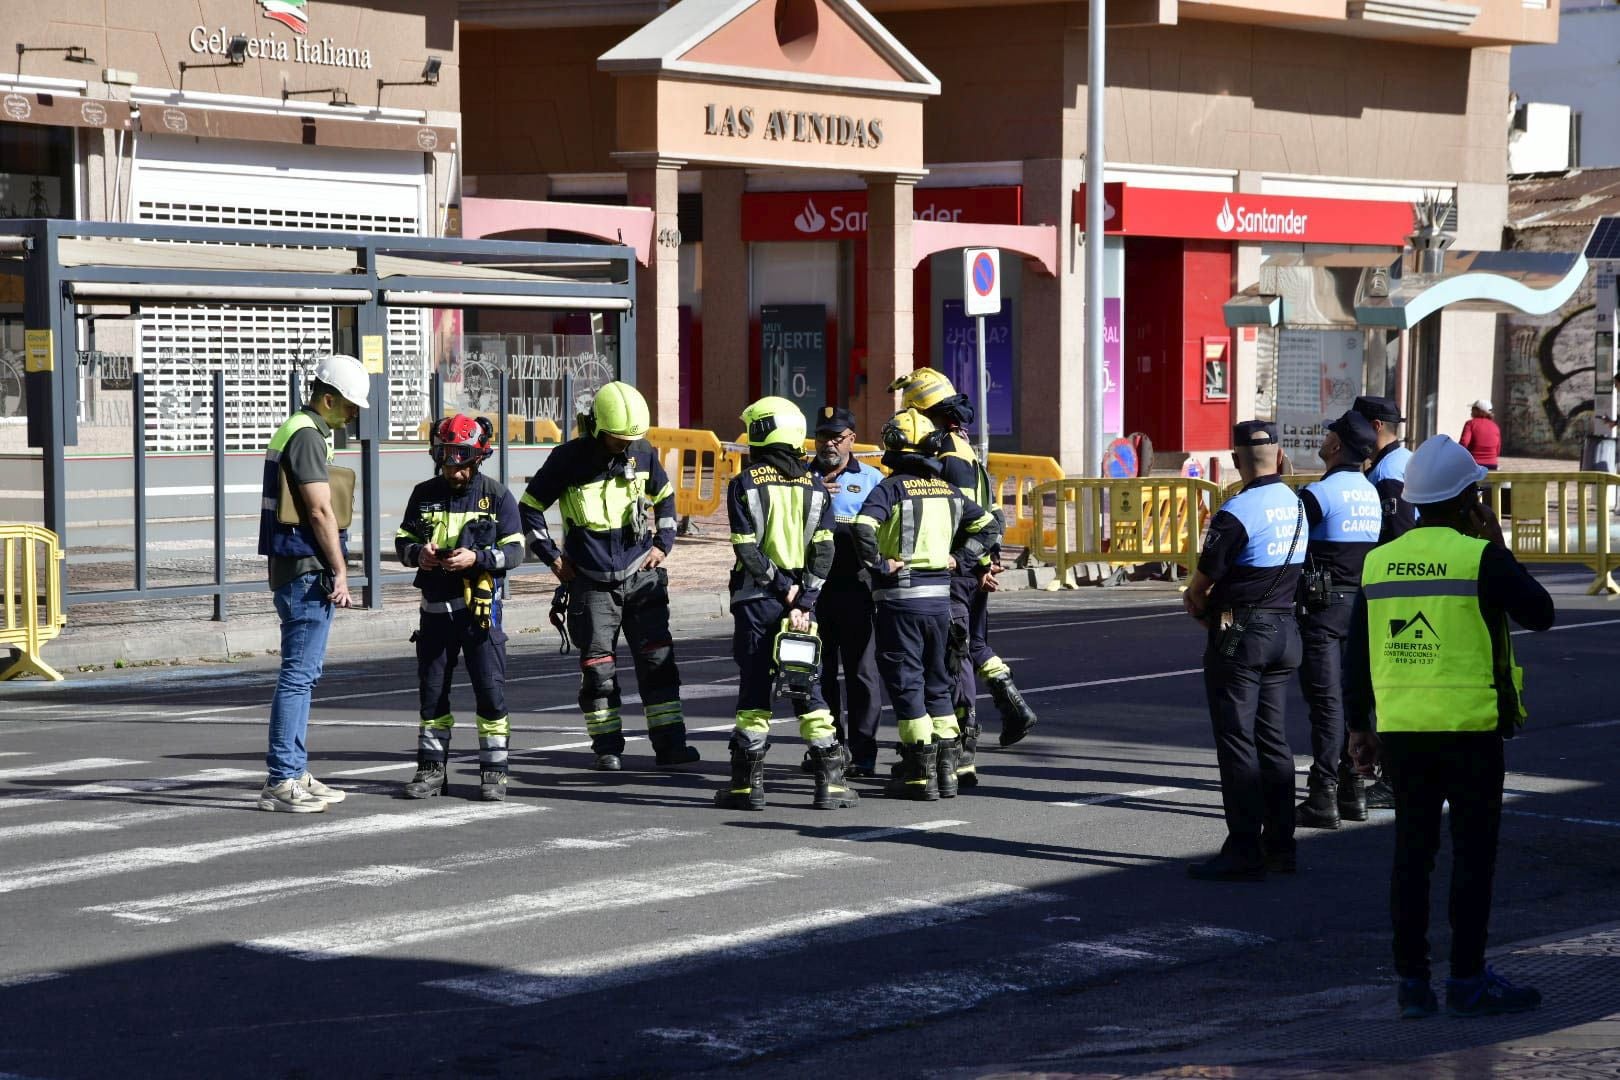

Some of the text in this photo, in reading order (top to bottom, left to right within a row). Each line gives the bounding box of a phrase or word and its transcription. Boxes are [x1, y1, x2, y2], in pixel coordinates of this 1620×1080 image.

[189, 26, 372, 69] Geleria Italiana
[704, 103, 884, 149] LAS AVENIDAS
[1236, 207, 1307, 235] Santander
[763, 323, 782, 331] MUY
[763, 332, 822, 349] FUERTE
[946, 326, 1008, 345] ¿HOA?
[1283, 423, 1297, 435] La
[1282, 438, 1300, 448] me
[753, 474, 777, 485] GRAN
[907, 488, 928, 496] GRAN
[1387, 562, 1448, 576] PERSAN
[1384, 642, 1433, 650] CUBIERTAS
